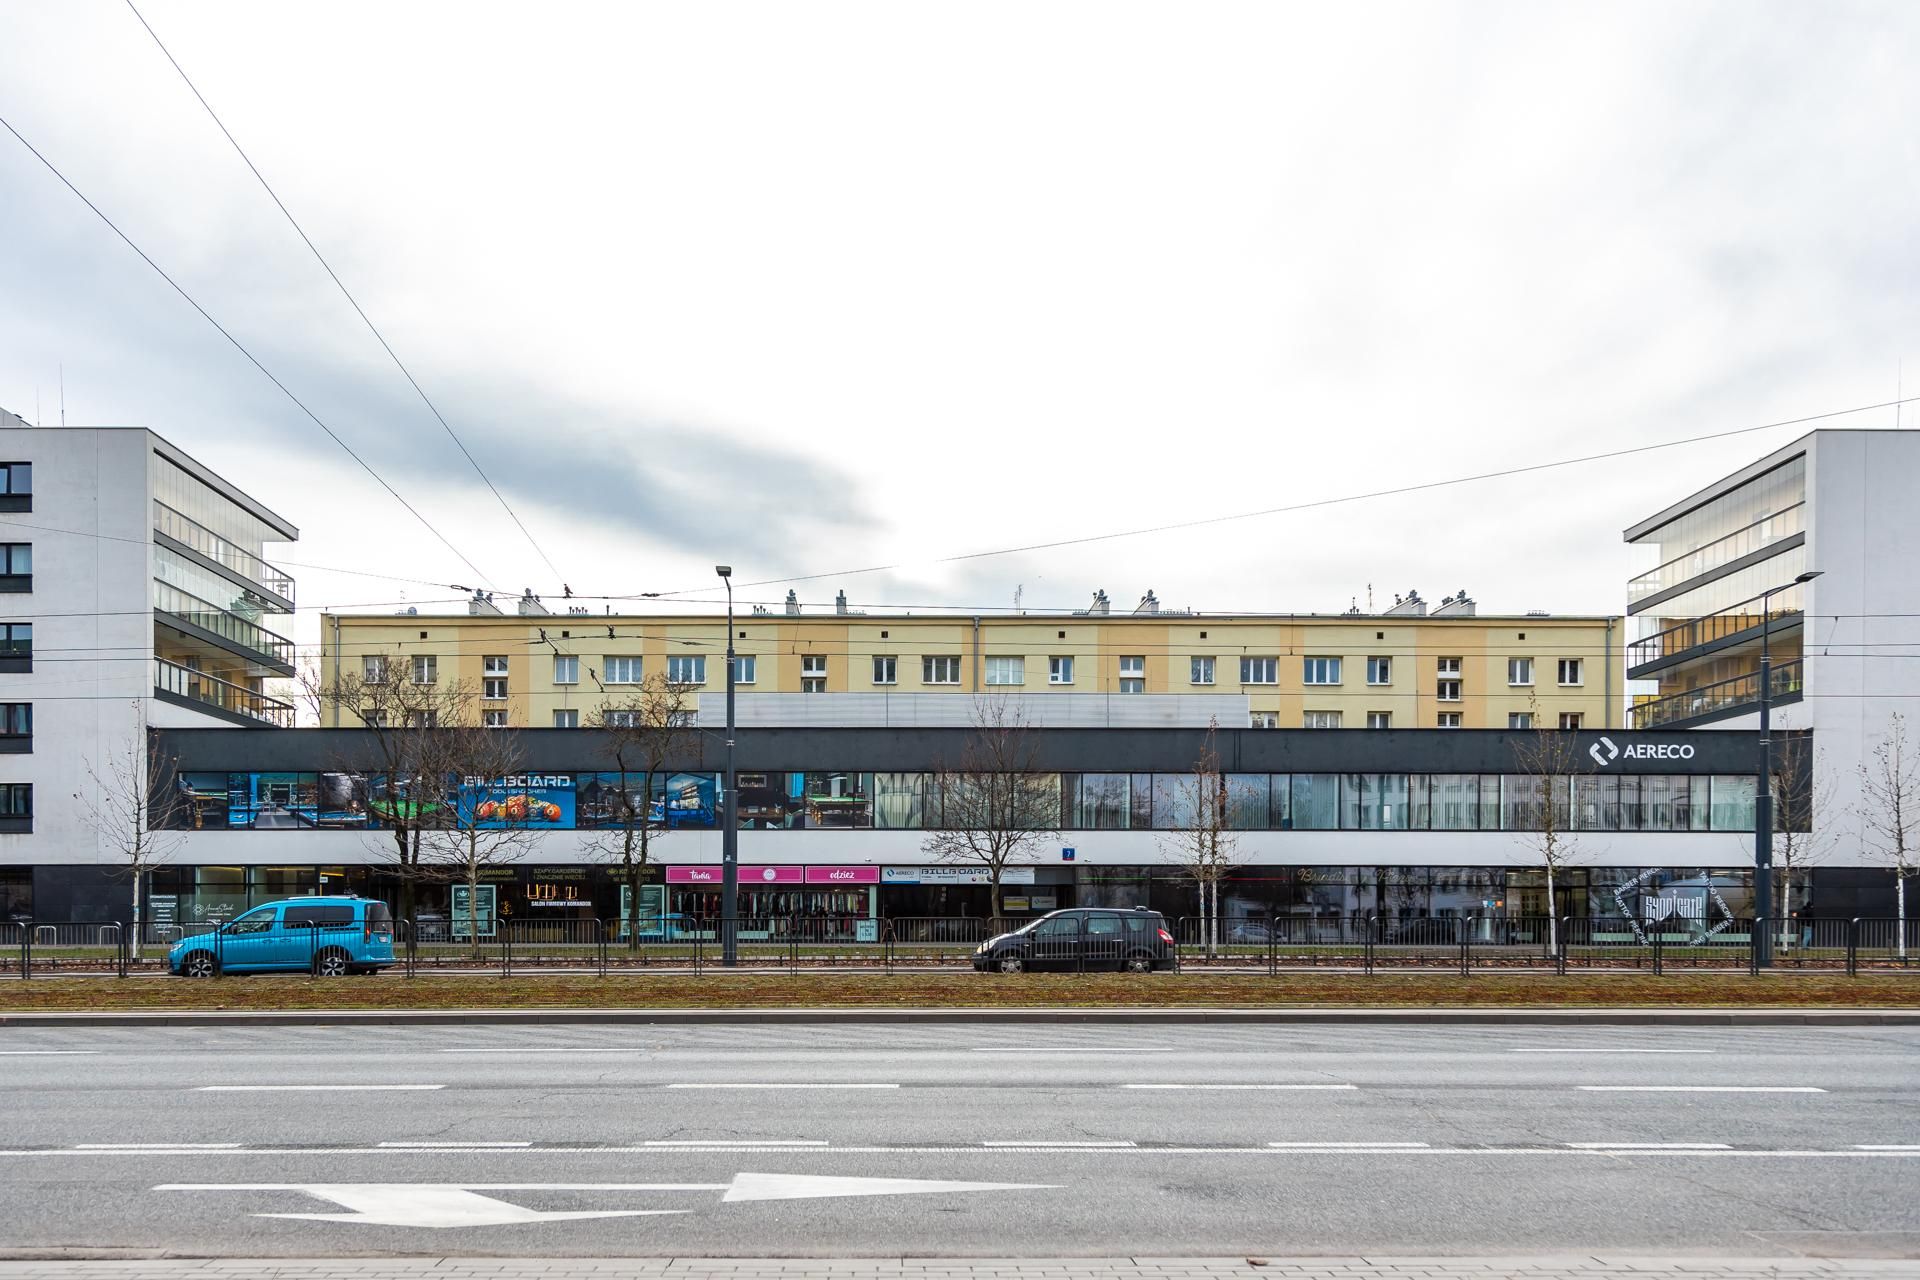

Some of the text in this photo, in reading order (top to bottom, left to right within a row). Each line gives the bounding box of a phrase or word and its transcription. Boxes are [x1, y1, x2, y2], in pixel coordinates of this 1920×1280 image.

[1623, 744, 1695, 759] AERECO
[689, 869, 712, 880] tania
[1613, 878, 1639, 896] BARBER
